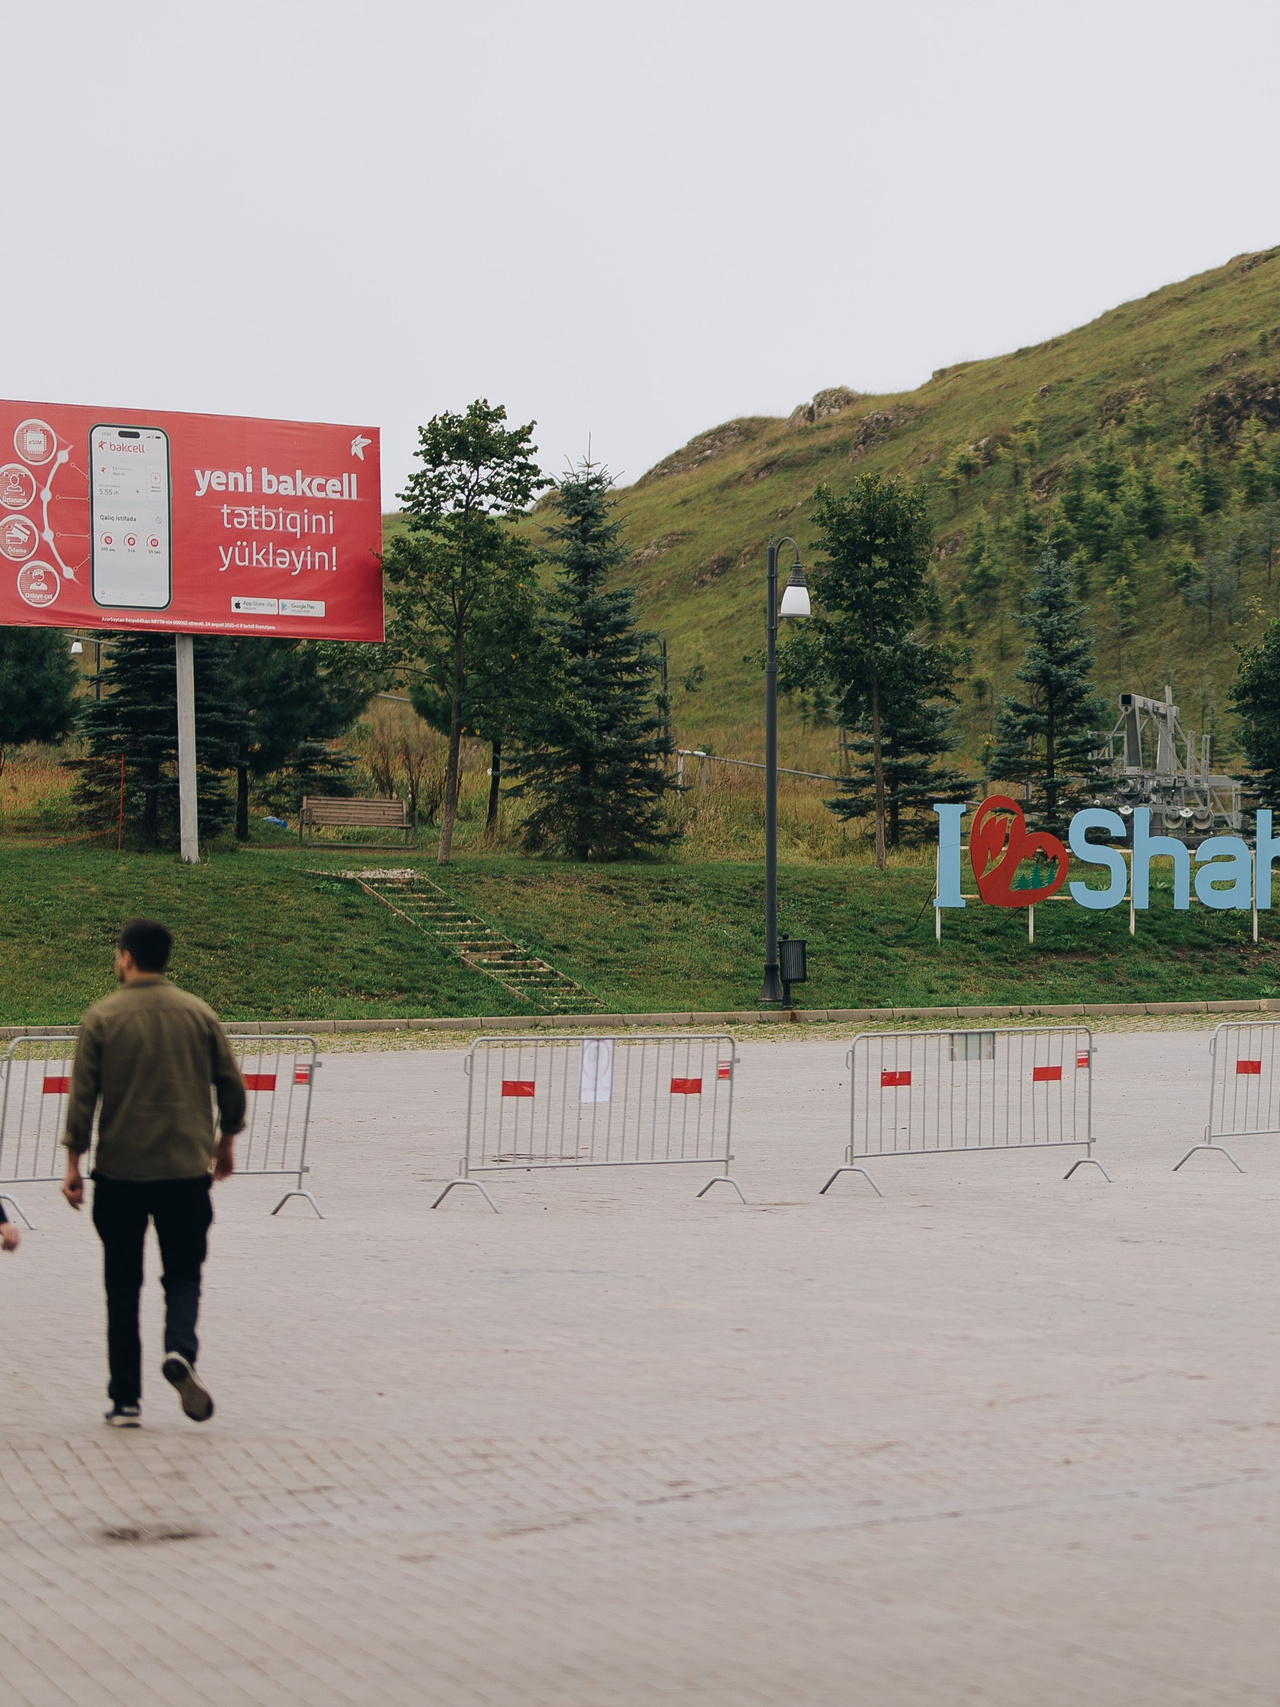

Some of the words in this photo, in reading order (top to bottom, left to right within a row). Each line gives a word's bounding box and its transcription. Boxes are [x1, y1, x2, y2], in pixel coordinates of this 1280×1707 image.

[109, 441, 146, 454] bakcell
[194, 466, 253, 497] yeni
[261, 467, 358, 500] bakcell
[220, 503, 334, 539] tətbiqini
[218, 540, 337, 576] yükləyin!
[933, 804, 966, 908] I
